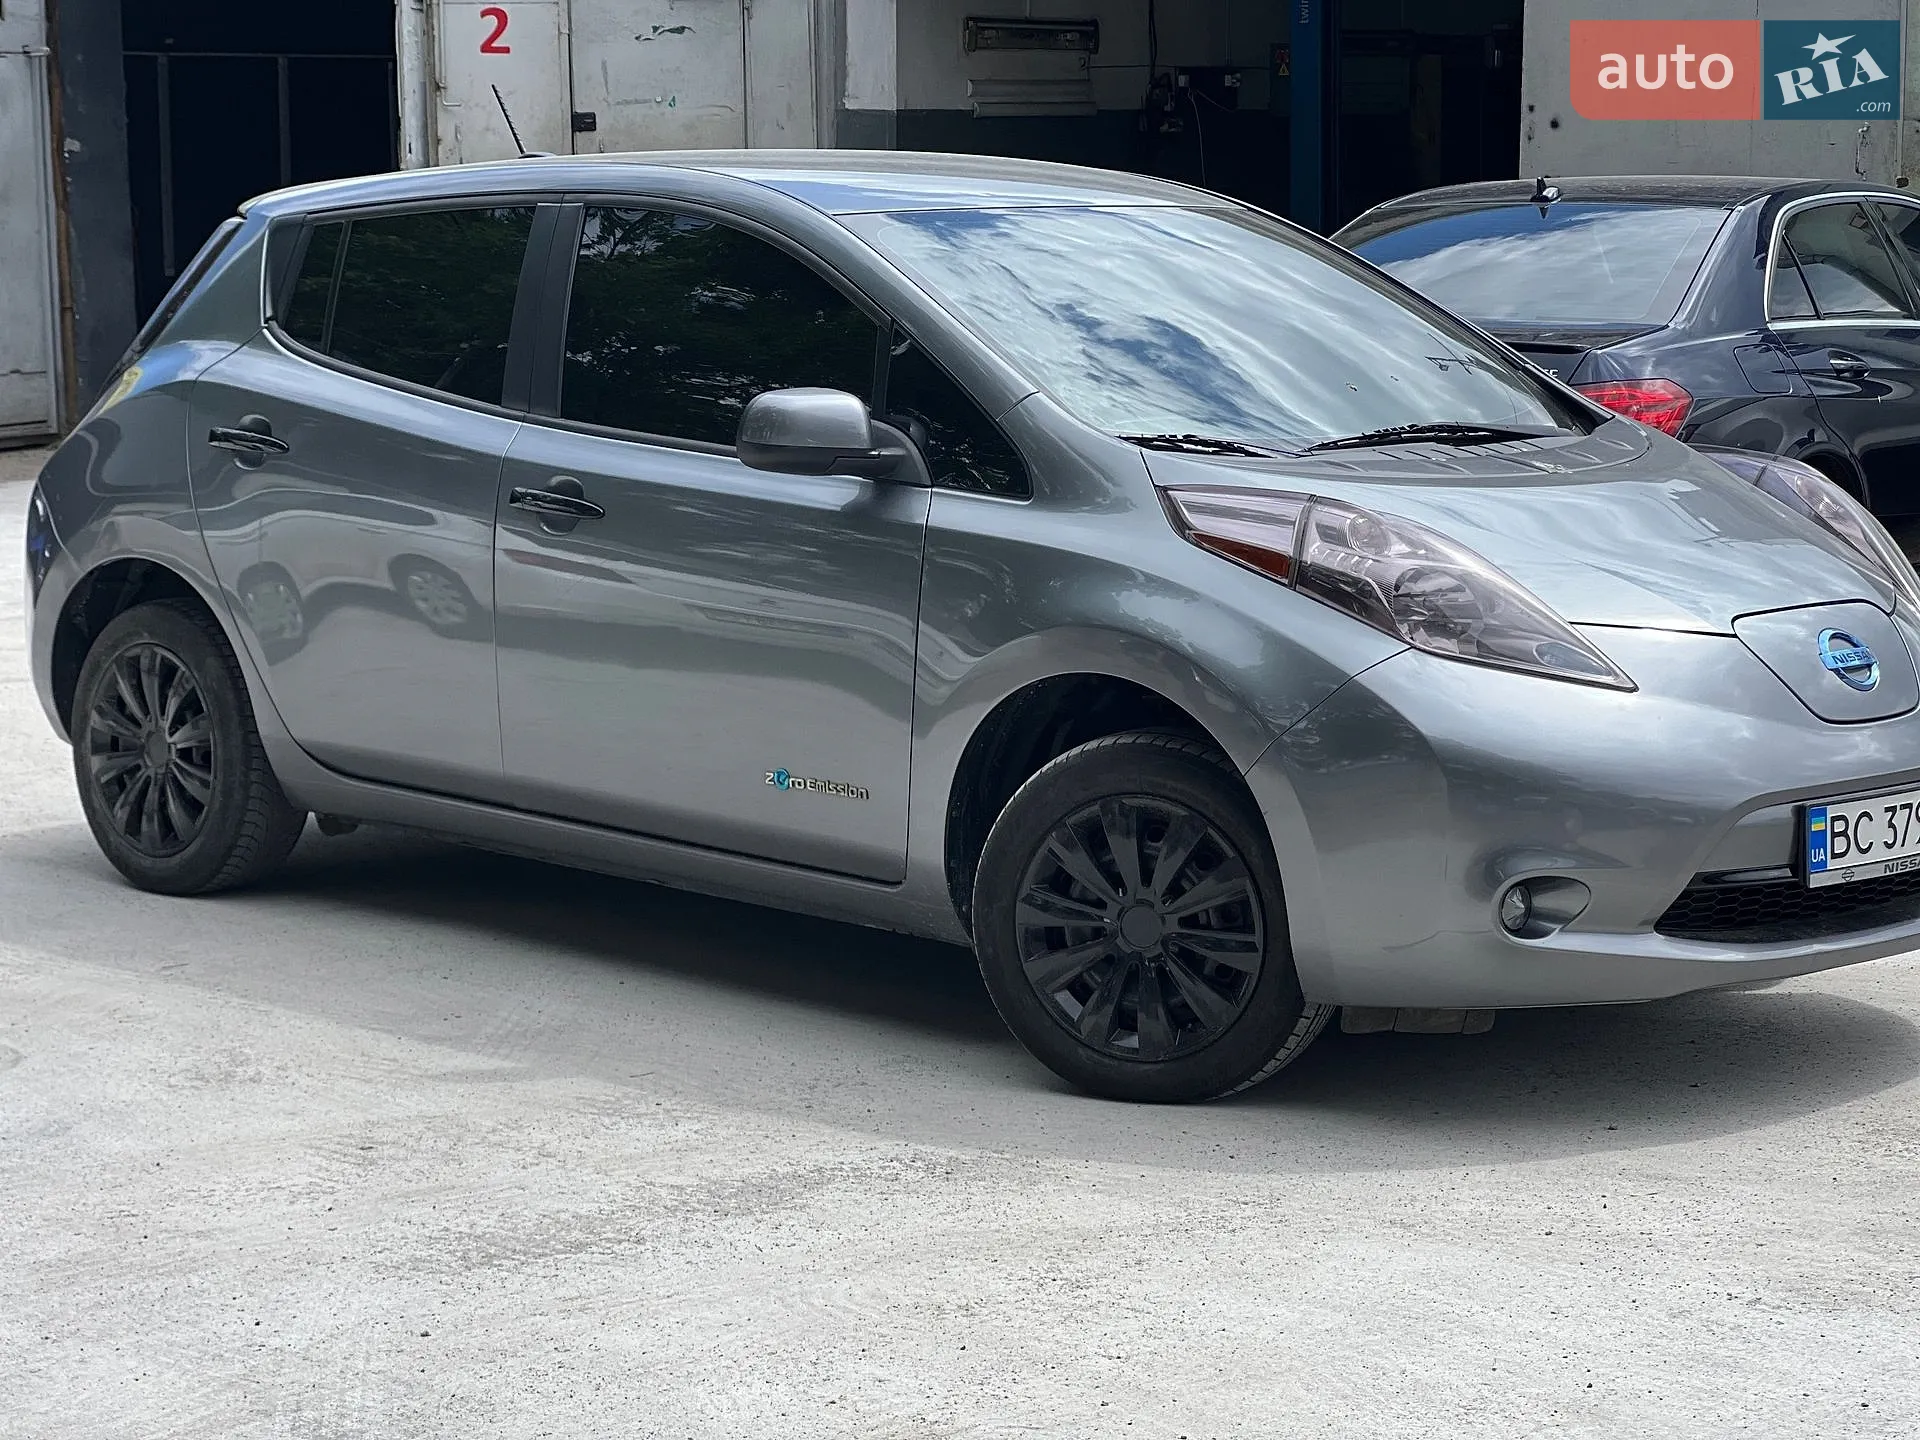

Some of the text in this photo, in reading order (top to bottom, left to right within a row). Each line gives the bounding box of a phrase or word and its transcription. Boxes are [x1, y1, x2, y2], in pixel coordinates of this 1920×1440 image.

[480, 7, 511, 54] 2
[1832, 649, 1872, 666] NISSA
[807, 778, 869, 800] Emission
[1830, 810, 1874, 860] BC
[1811, 847, 1826, 863] UA
